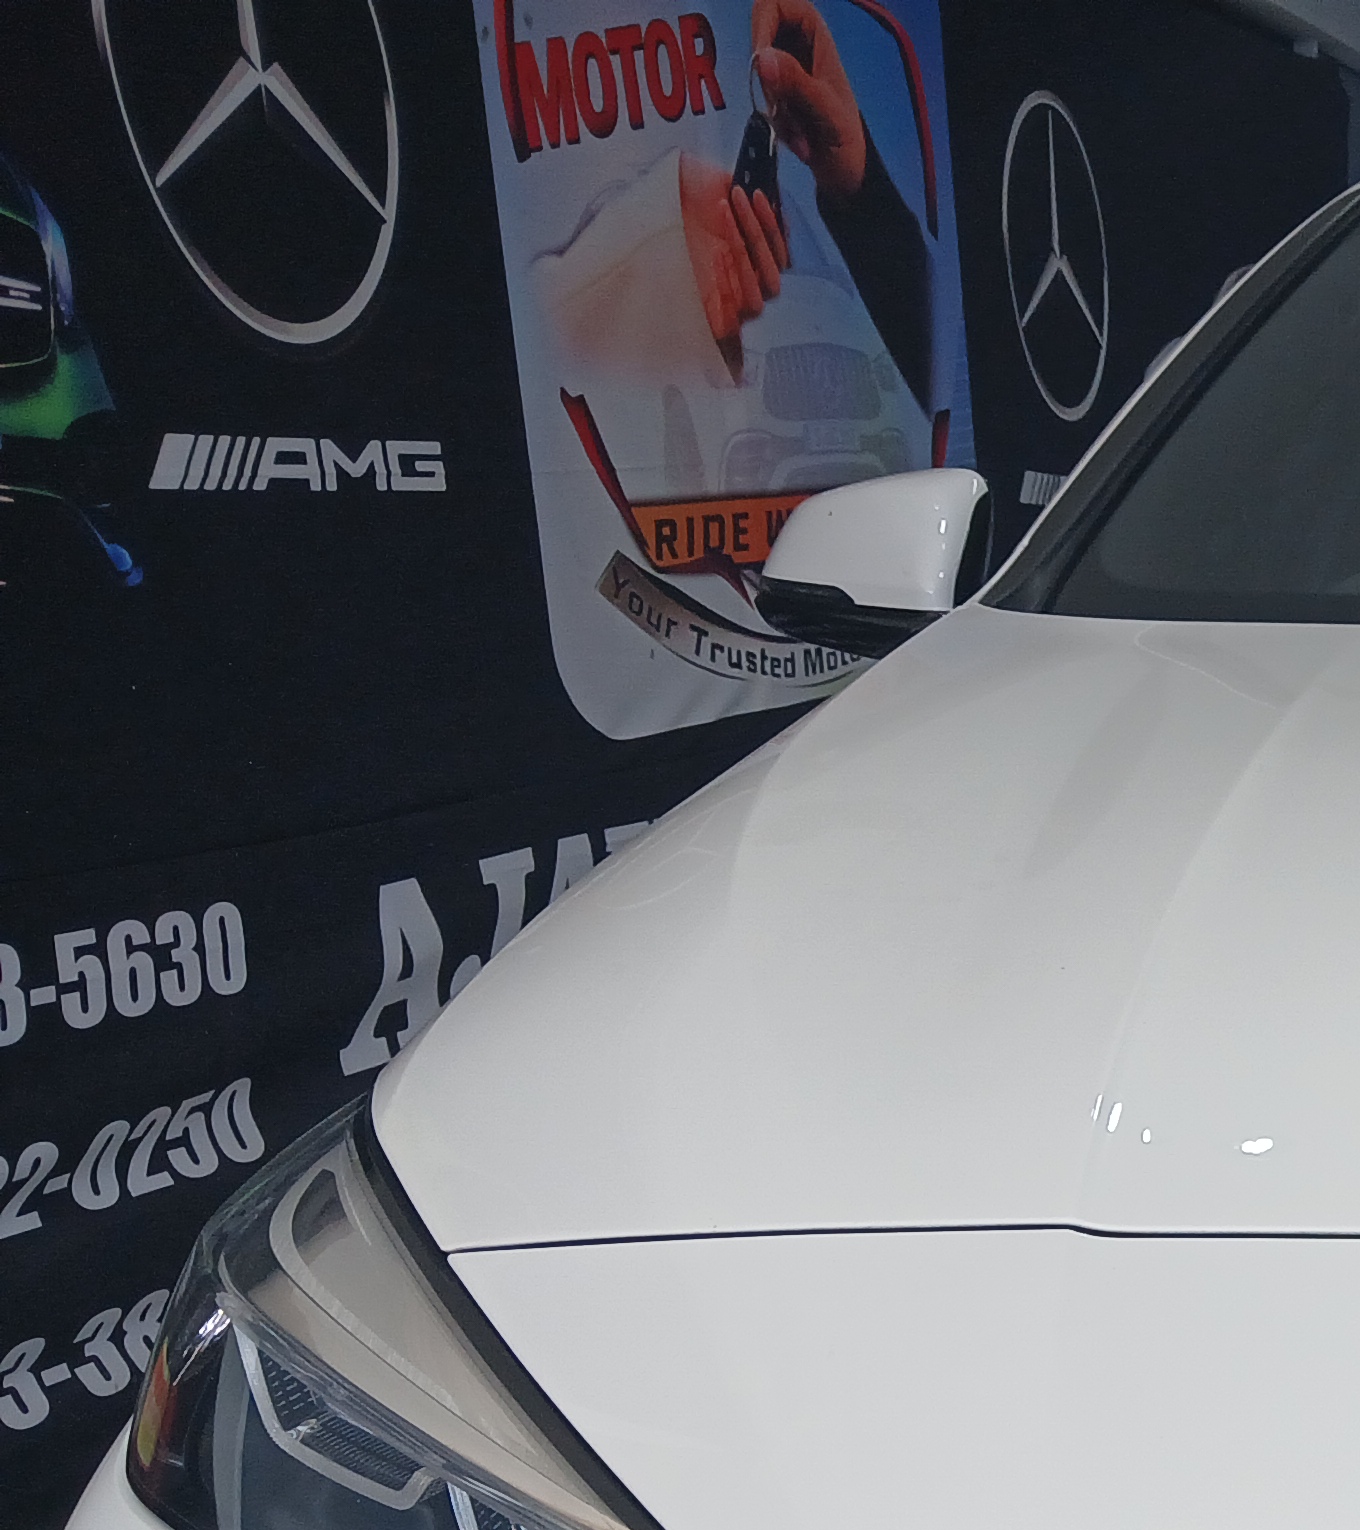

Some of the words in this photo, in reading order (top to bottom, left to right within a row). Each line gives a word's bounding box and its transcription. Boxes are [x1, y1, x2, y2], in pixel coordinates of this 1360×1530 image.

[514, 12, 726, 153] MOTOR
[251, 437, 447, 491] AMG
[653, 511, 750, 562] RIDE
[611, 565, 679, 640] Your
[690, 624, 796, 680] Trusted
[0, 1078, 265, 1240] 2-0250
